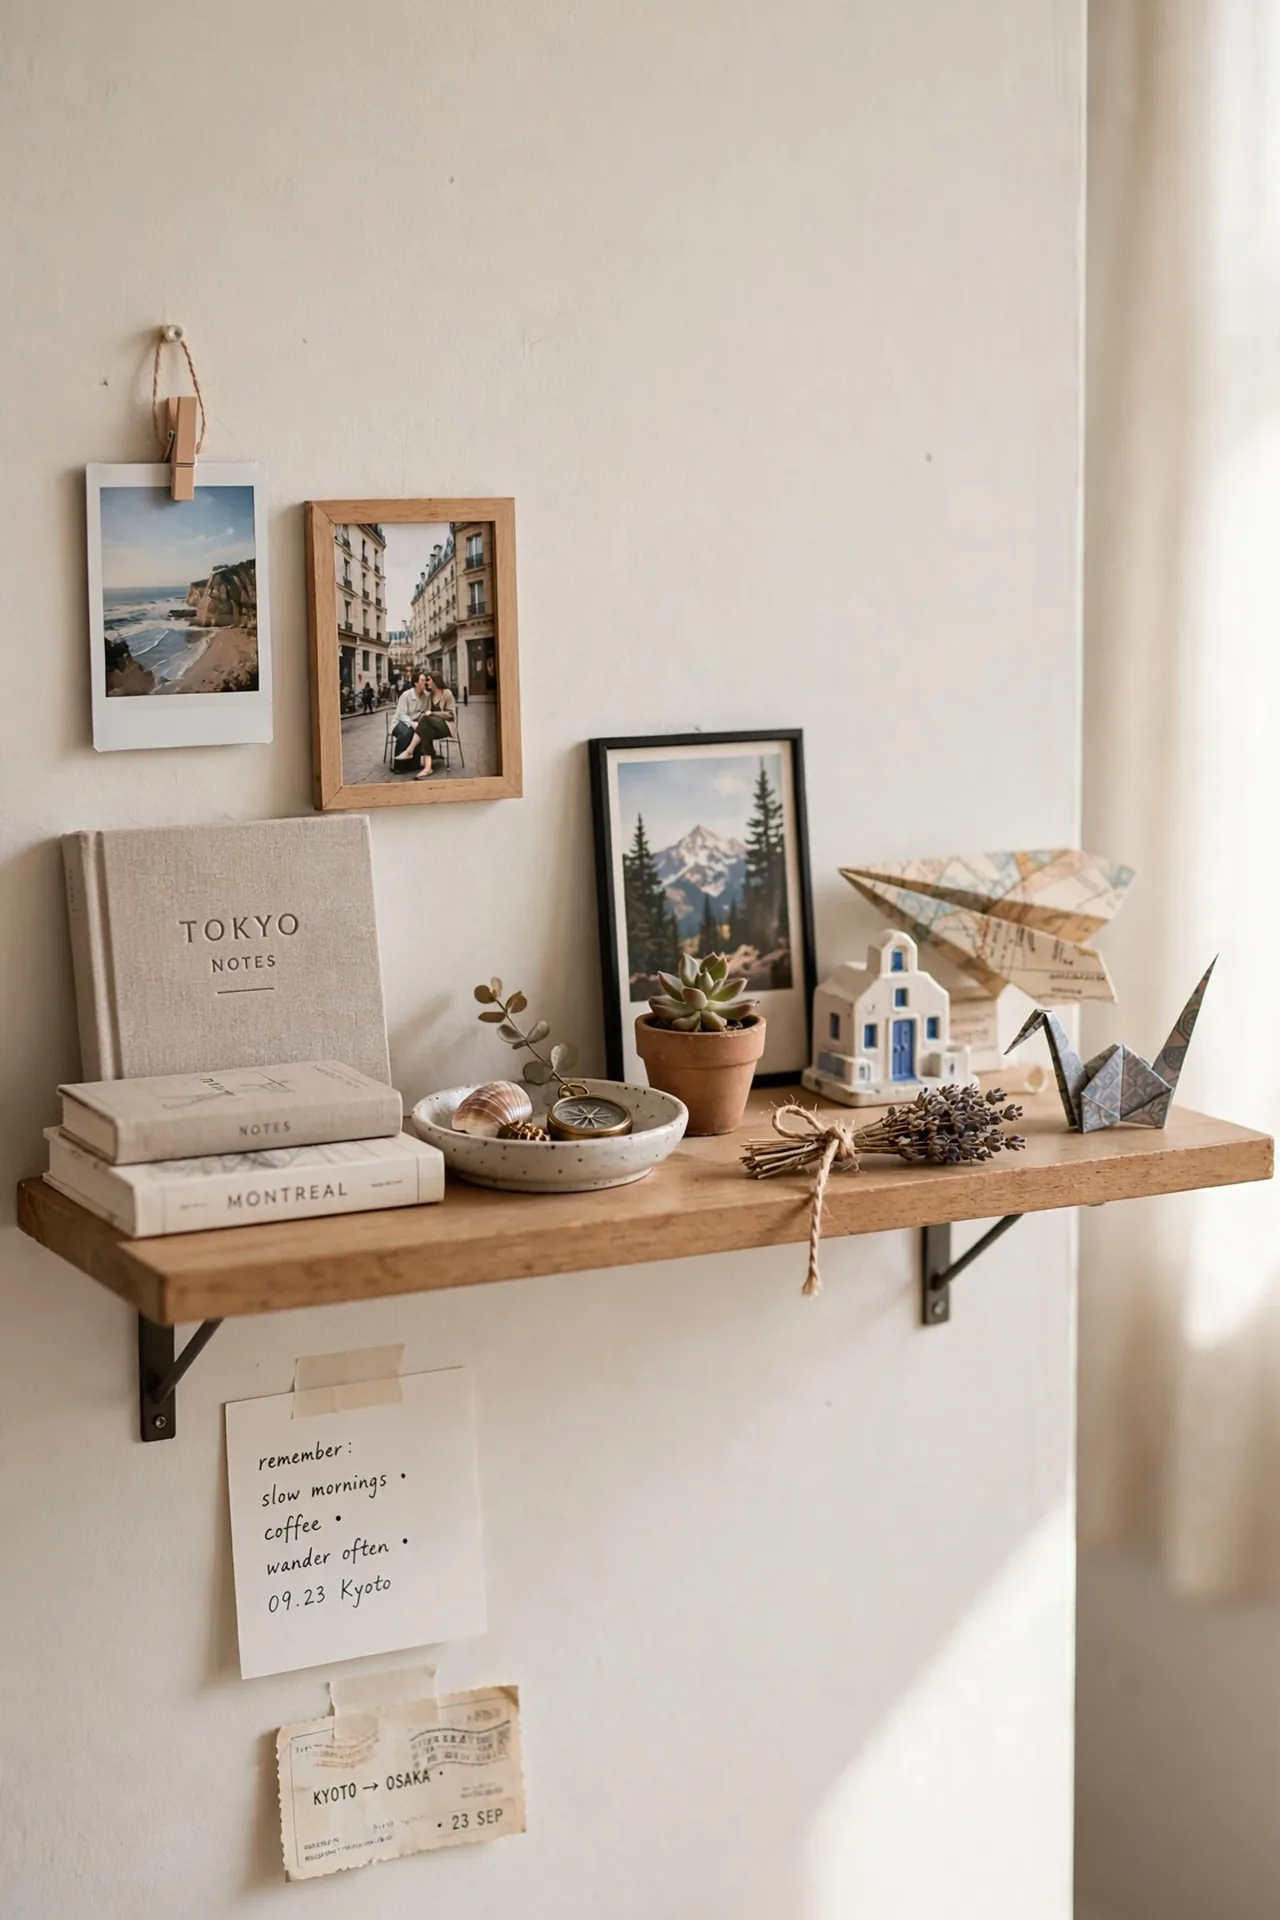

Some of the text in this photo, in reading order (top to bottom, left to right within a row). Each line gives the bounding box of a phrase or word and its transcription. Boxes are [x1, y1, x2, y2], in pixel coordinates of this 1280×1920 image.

[179, 913, 299, 943] TOKYO
[211, 954, 276, 973] NOTES
[238, 1120, 292, 1137] NOTES
[227, 1181, 348, 1210] MONTREAL
[262, 1473, 388, 1507] slow mornings
[264, 1514, 322, 1543] coffee
[267, 1538, 389, 1576] wander often
[268, 1575, 391, 1613] 09.23 Kyoto
[313, 1769, 430, 1805] KYOTO OSAKA
[452, 1808, 504, 1831] 23 SEP
